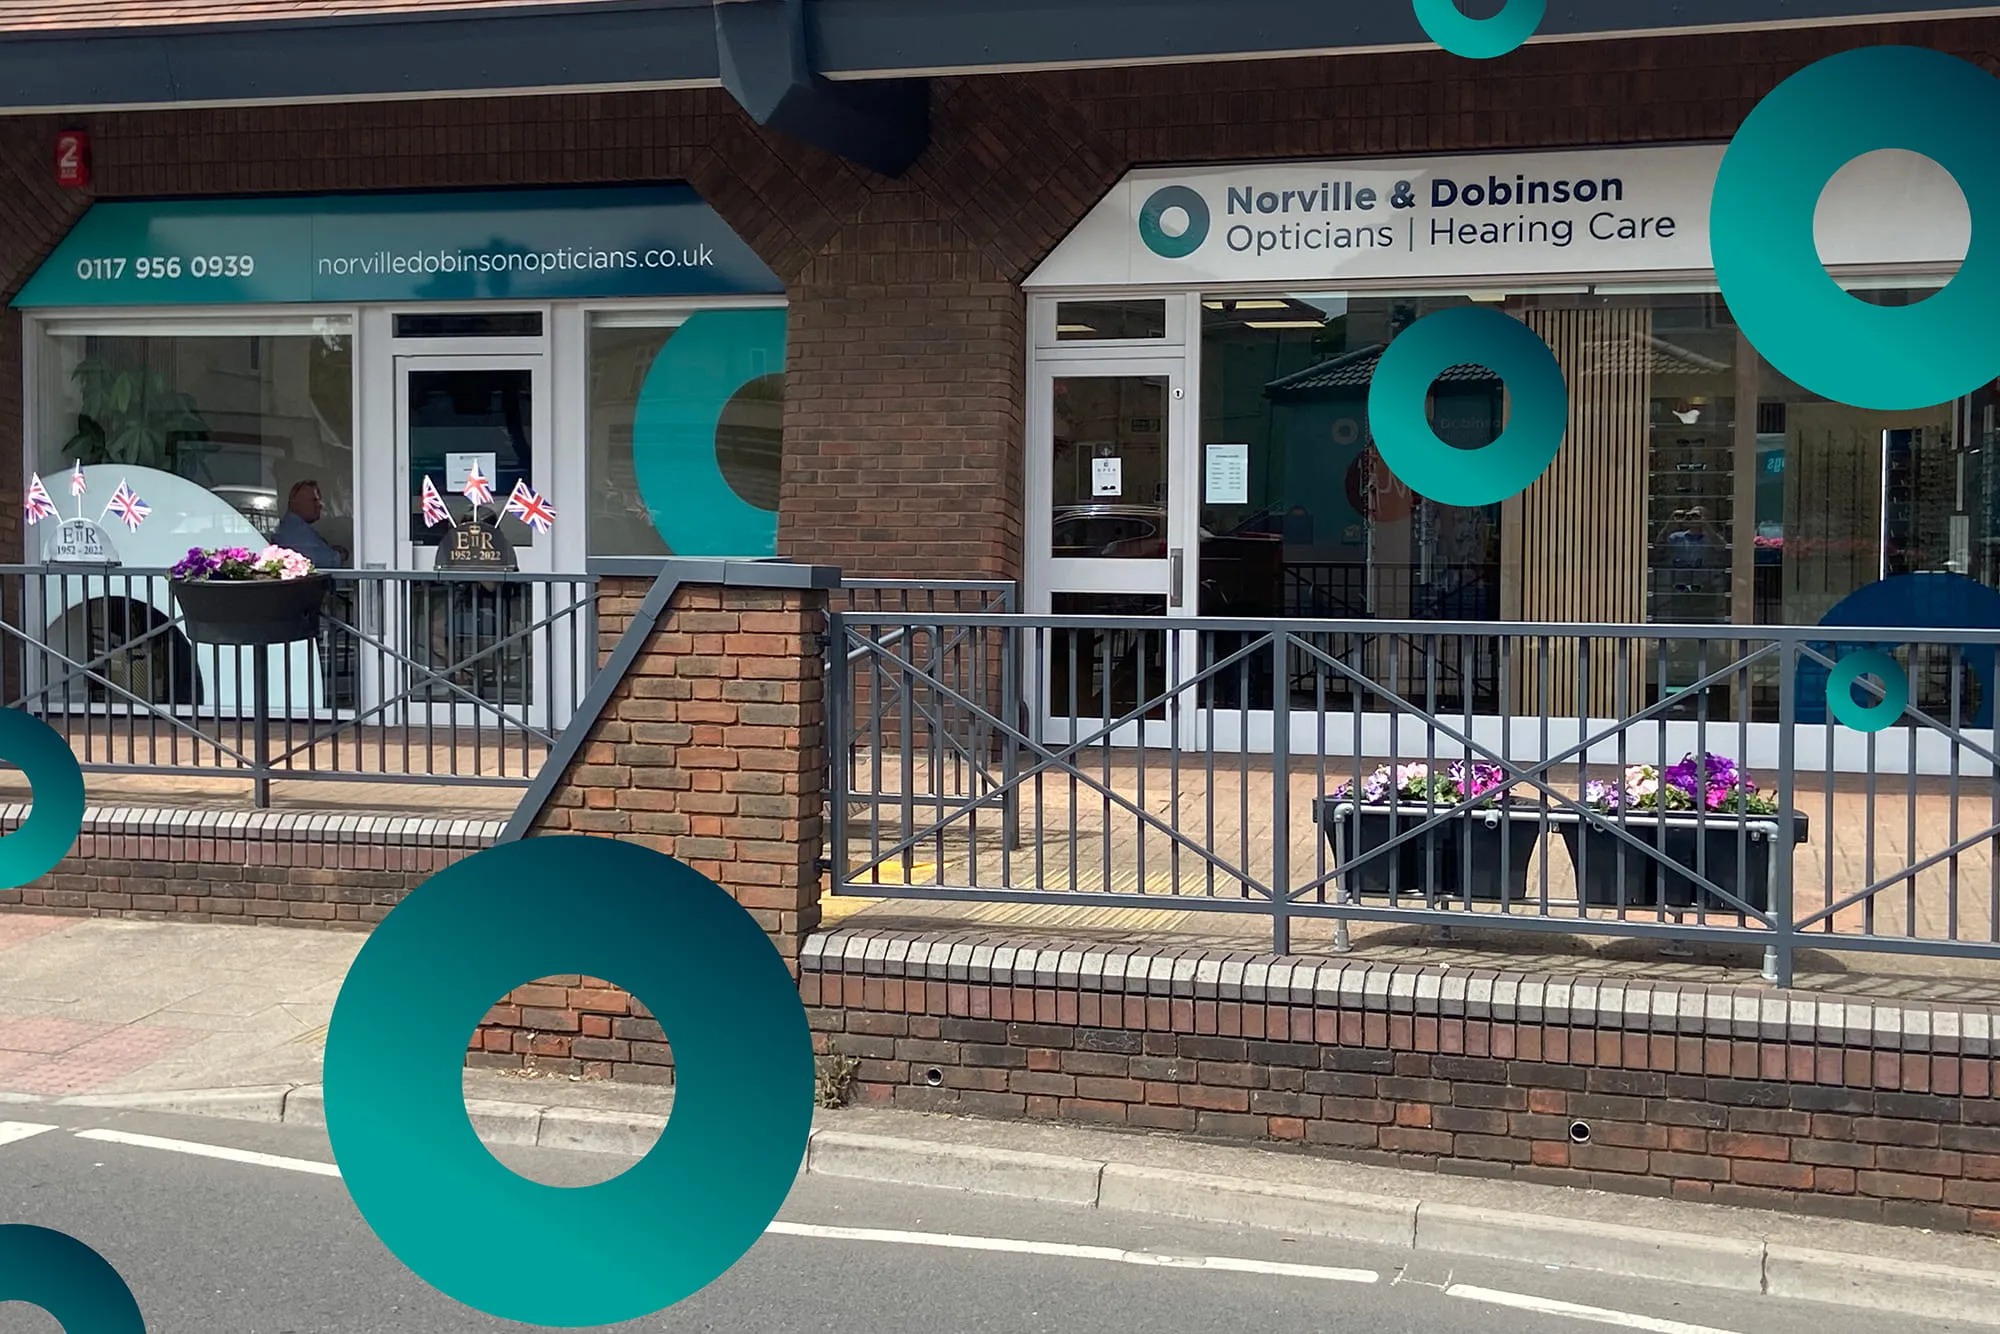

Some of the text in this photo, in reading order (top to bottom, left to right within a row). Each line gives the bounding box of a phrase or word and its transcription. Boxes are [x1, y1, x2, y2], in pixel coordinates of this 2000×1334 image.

[1227, 174, 1624, 215] Norville & Dobinson
[1226, 221, 1394, 256] Opticians
[1430, 214, 1574, 246] Hearing
[1589, 211, 1676, 240] Care
[77, 255, 255, 280] 0117 956 0939
[318, 243, 714, 275] norvilledobinsonopticians.co.uk
[57, 545, 76, 555] 1952
[84, 545, 103, 555] 2022
[450, 550, 471, 560] 1952
[479, 550, 501, 560] 2022
